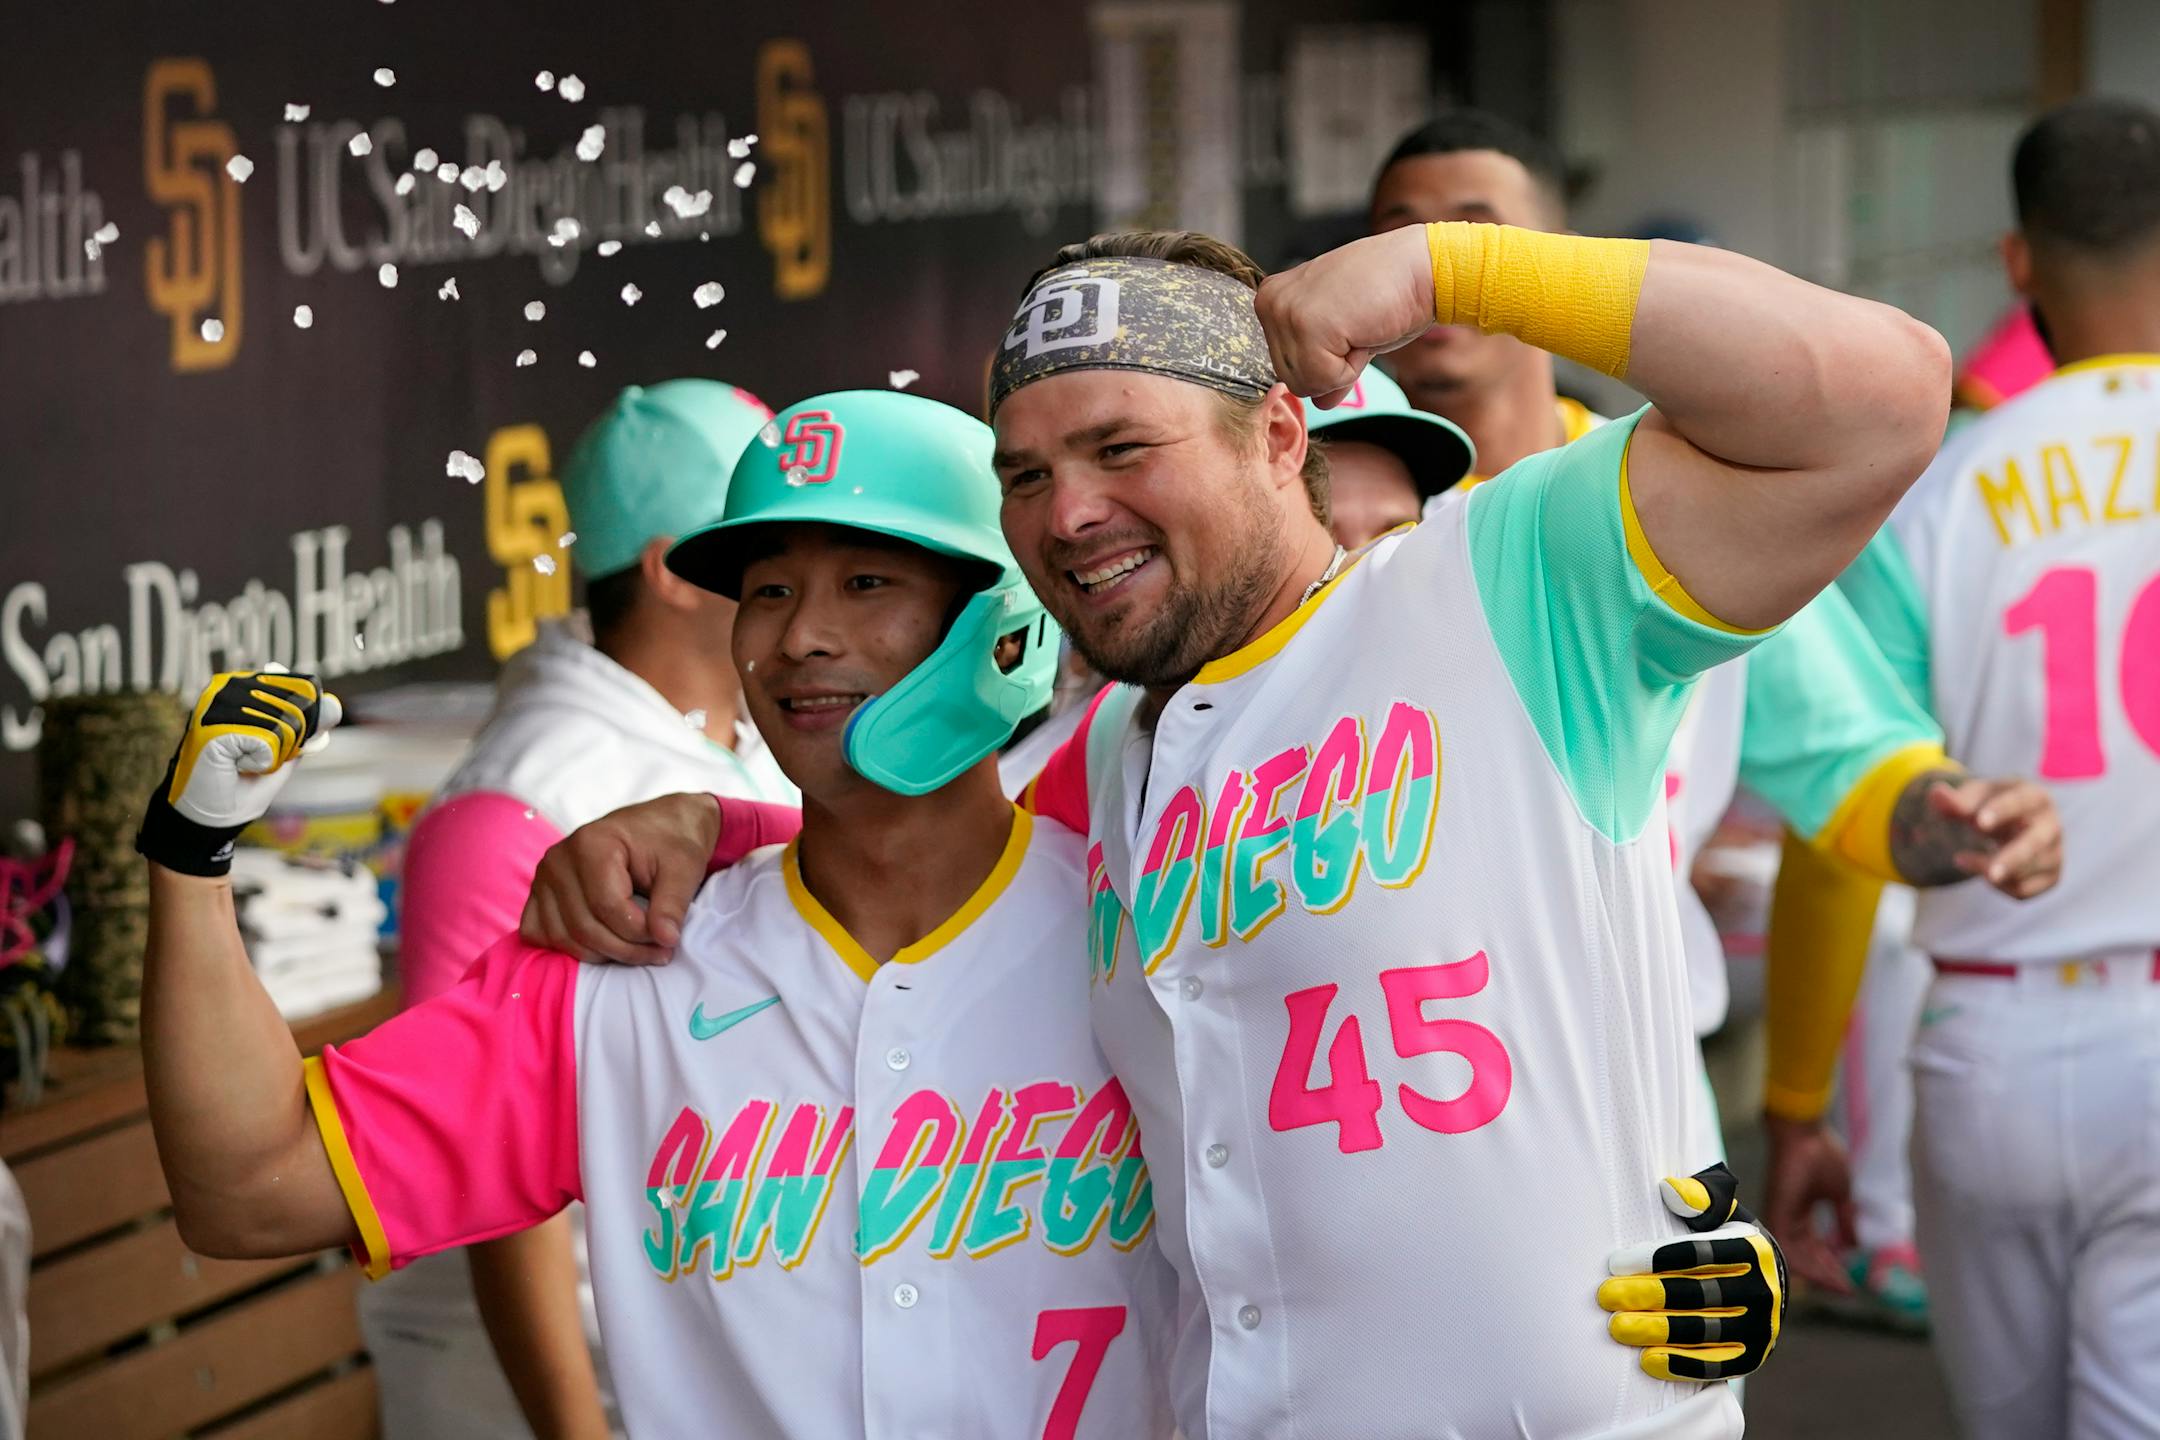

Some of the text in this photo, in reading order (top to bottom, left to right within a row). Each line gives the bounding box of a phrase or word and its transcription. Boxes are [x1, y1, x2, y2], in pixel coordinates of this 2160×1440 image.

[1974, 428, 2160, 547] MAZ
[2, 581, 122, 750] San
[293, 518, 463, 679] Health
[1131, 697, 1442, 976] DIEGO
[1268, 949, 1513, 1155] 45
[642, 1098, 856, 1284] SAN
[1031, 1305, 1128, 1440] 7
